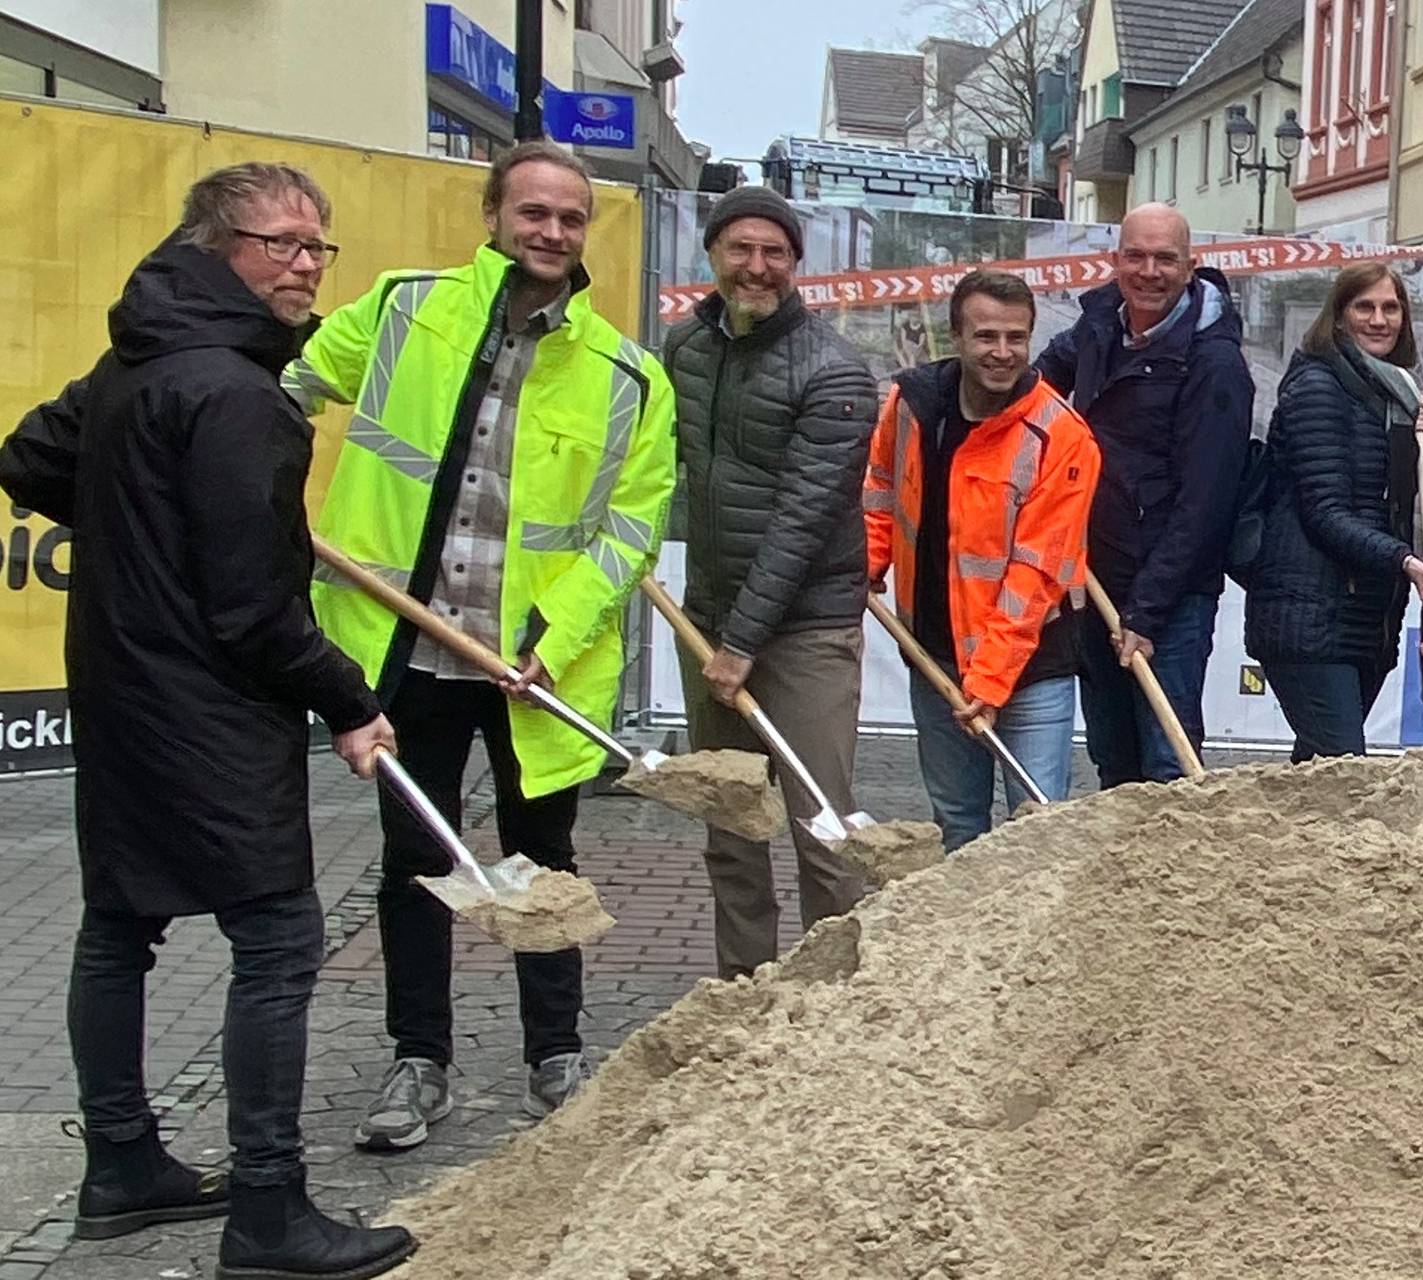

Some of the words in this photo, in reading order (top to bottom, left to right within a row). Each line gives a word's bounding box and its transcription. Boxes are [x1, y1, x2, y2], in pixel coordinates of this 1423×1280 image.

[571, 123, 625, 142] Apollo
[800, 280, 865, 305] ERL'S!
[1202, 246, 1276, 269] WERL'S!
